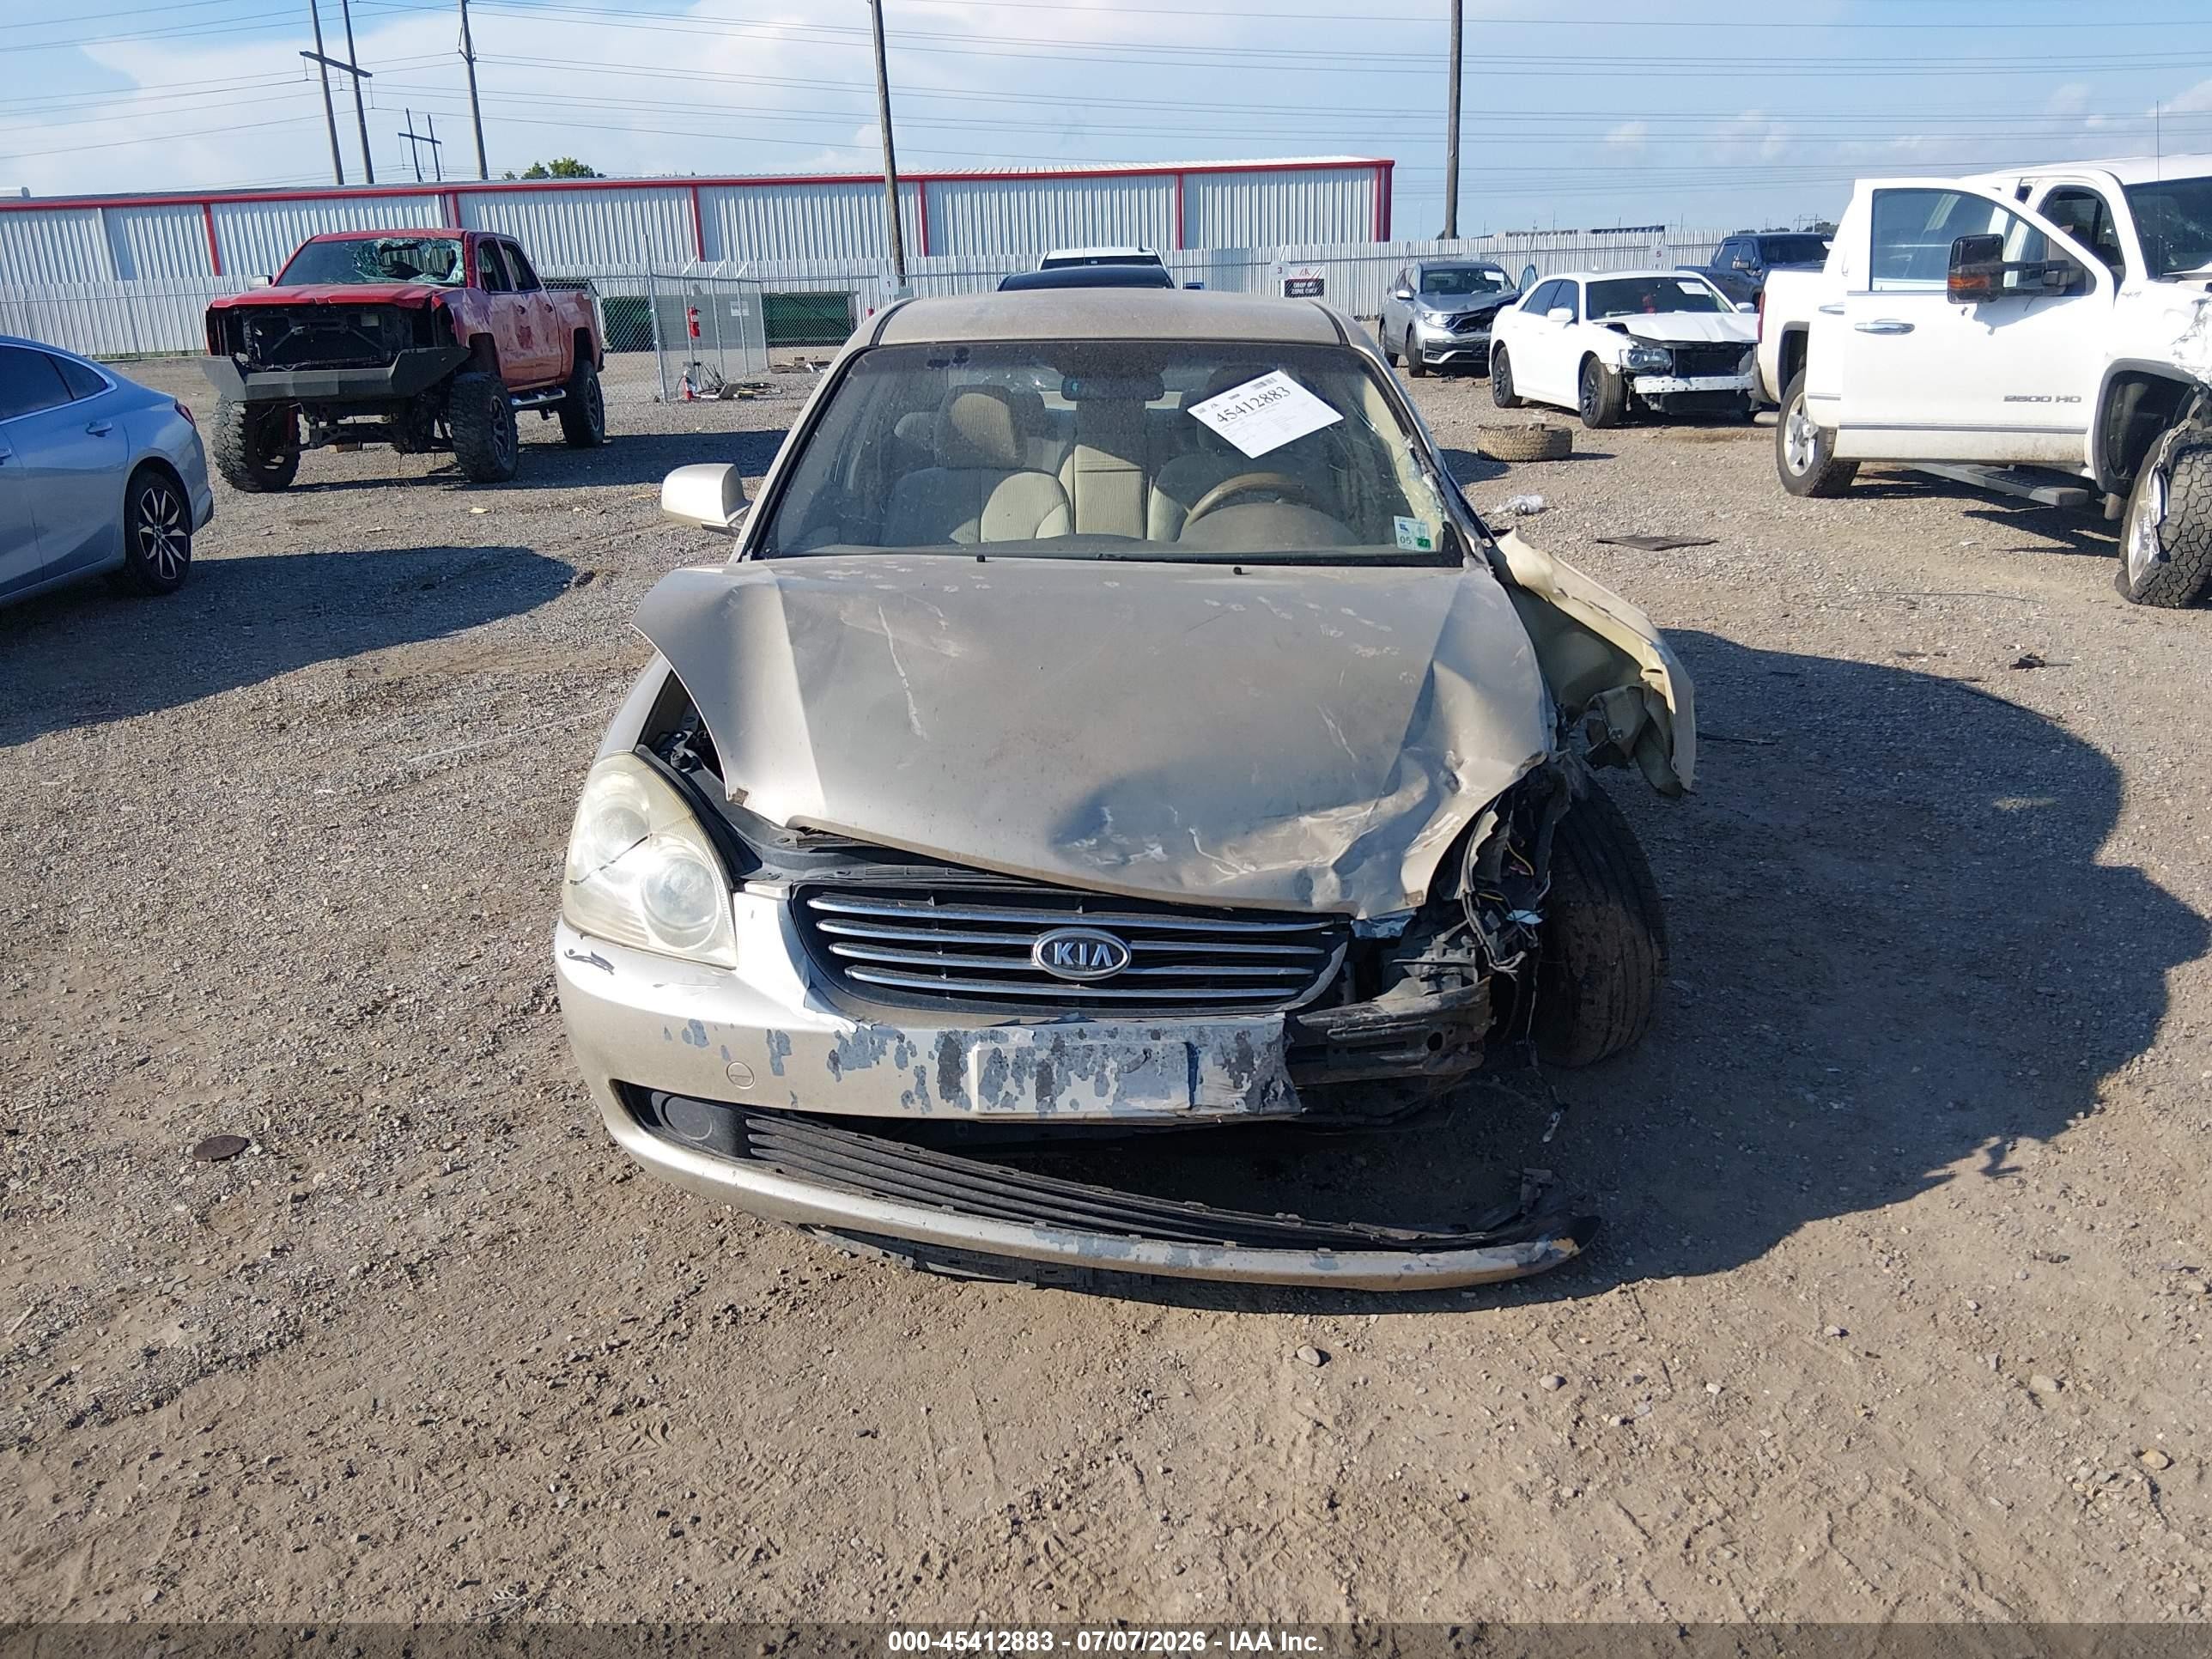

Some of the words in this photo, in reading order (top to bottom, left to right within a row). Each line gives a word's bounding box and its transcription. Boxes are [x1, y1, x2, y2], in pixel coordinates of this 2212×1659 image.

[1216, 386, 1291, 423] 45412883
[1400, 536, 1413, 544] 05
[1054, 941, 1114, 967] KIA
